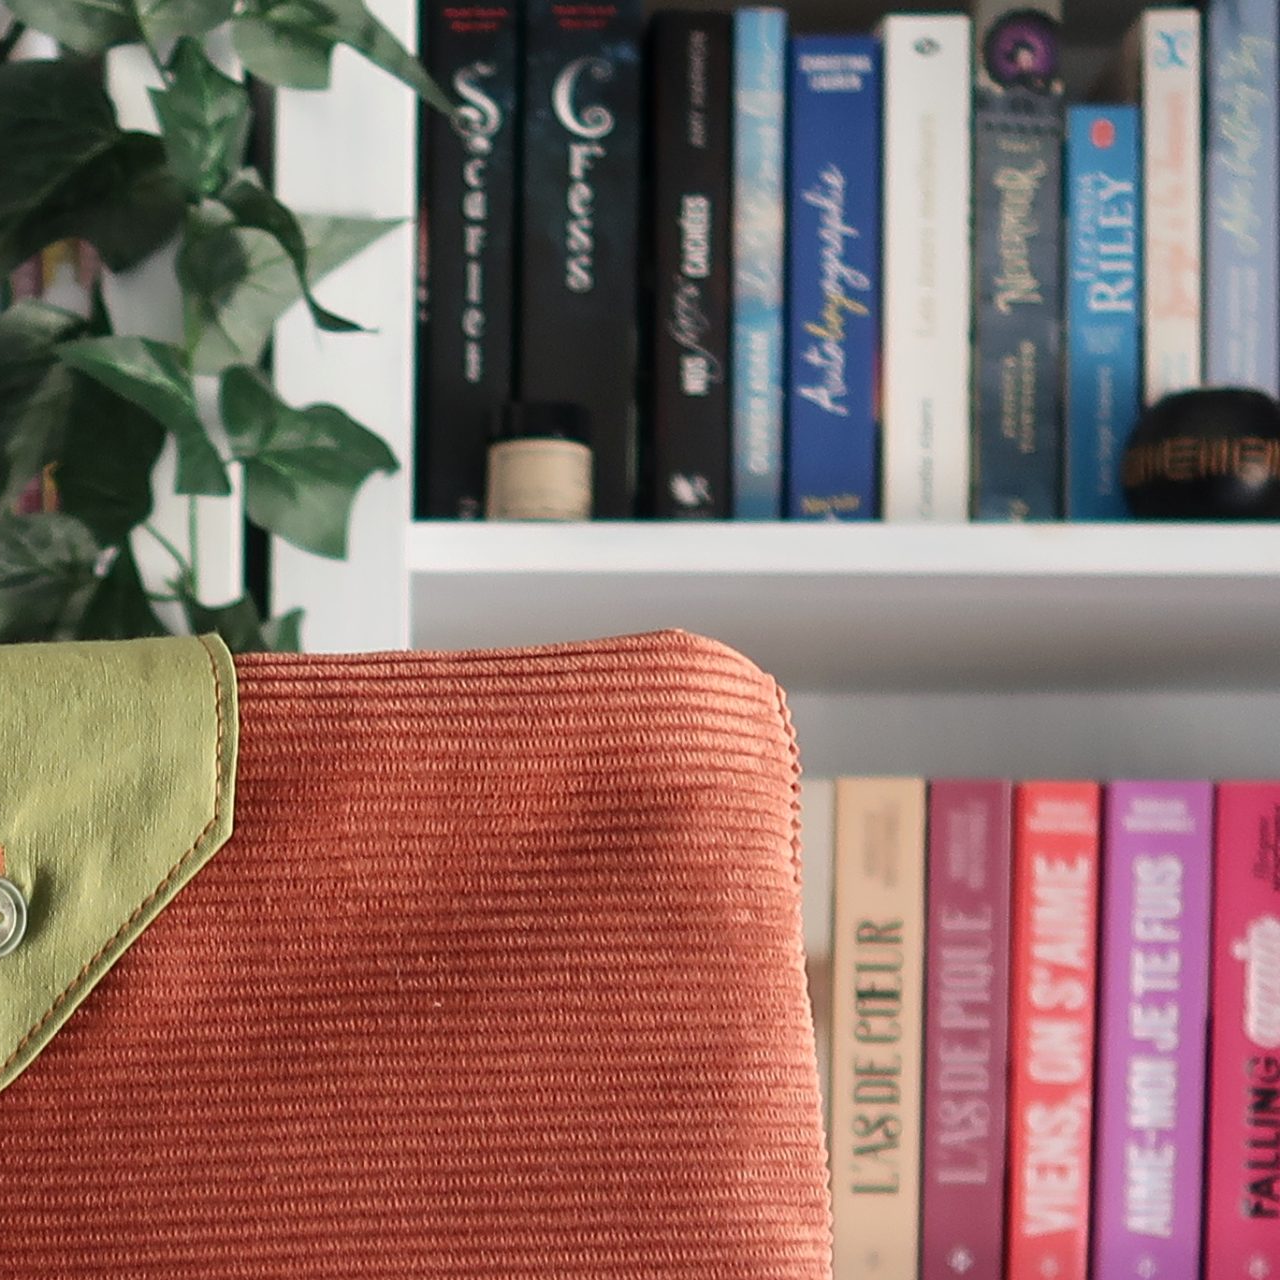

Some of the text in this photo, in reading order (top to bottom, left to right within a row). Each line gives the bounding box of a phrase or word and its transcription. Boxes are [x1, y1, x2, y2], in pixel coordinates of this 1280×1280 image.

[1087, 173, 1135, 314] RILEY
[1134, 855, 1185, 942] FUIS
[940, 905, 994, 1030] PIQUE
[1131, 948, 1181, 994] TE
[938, 1040, 991, 1092] DE
[1027, 1017, 1084, 1085] ON
[1129, 1000, 1179, 1052] JE
[853, 1054, 903, 1103] DE
[851, 1112, 902, 1194] L'AS
[937, 1102, 990, 1184] L'AS
[1022, 1094, 1089, 1237] VIENS,
[1241, 1055, 1280, 1219] FALLING
